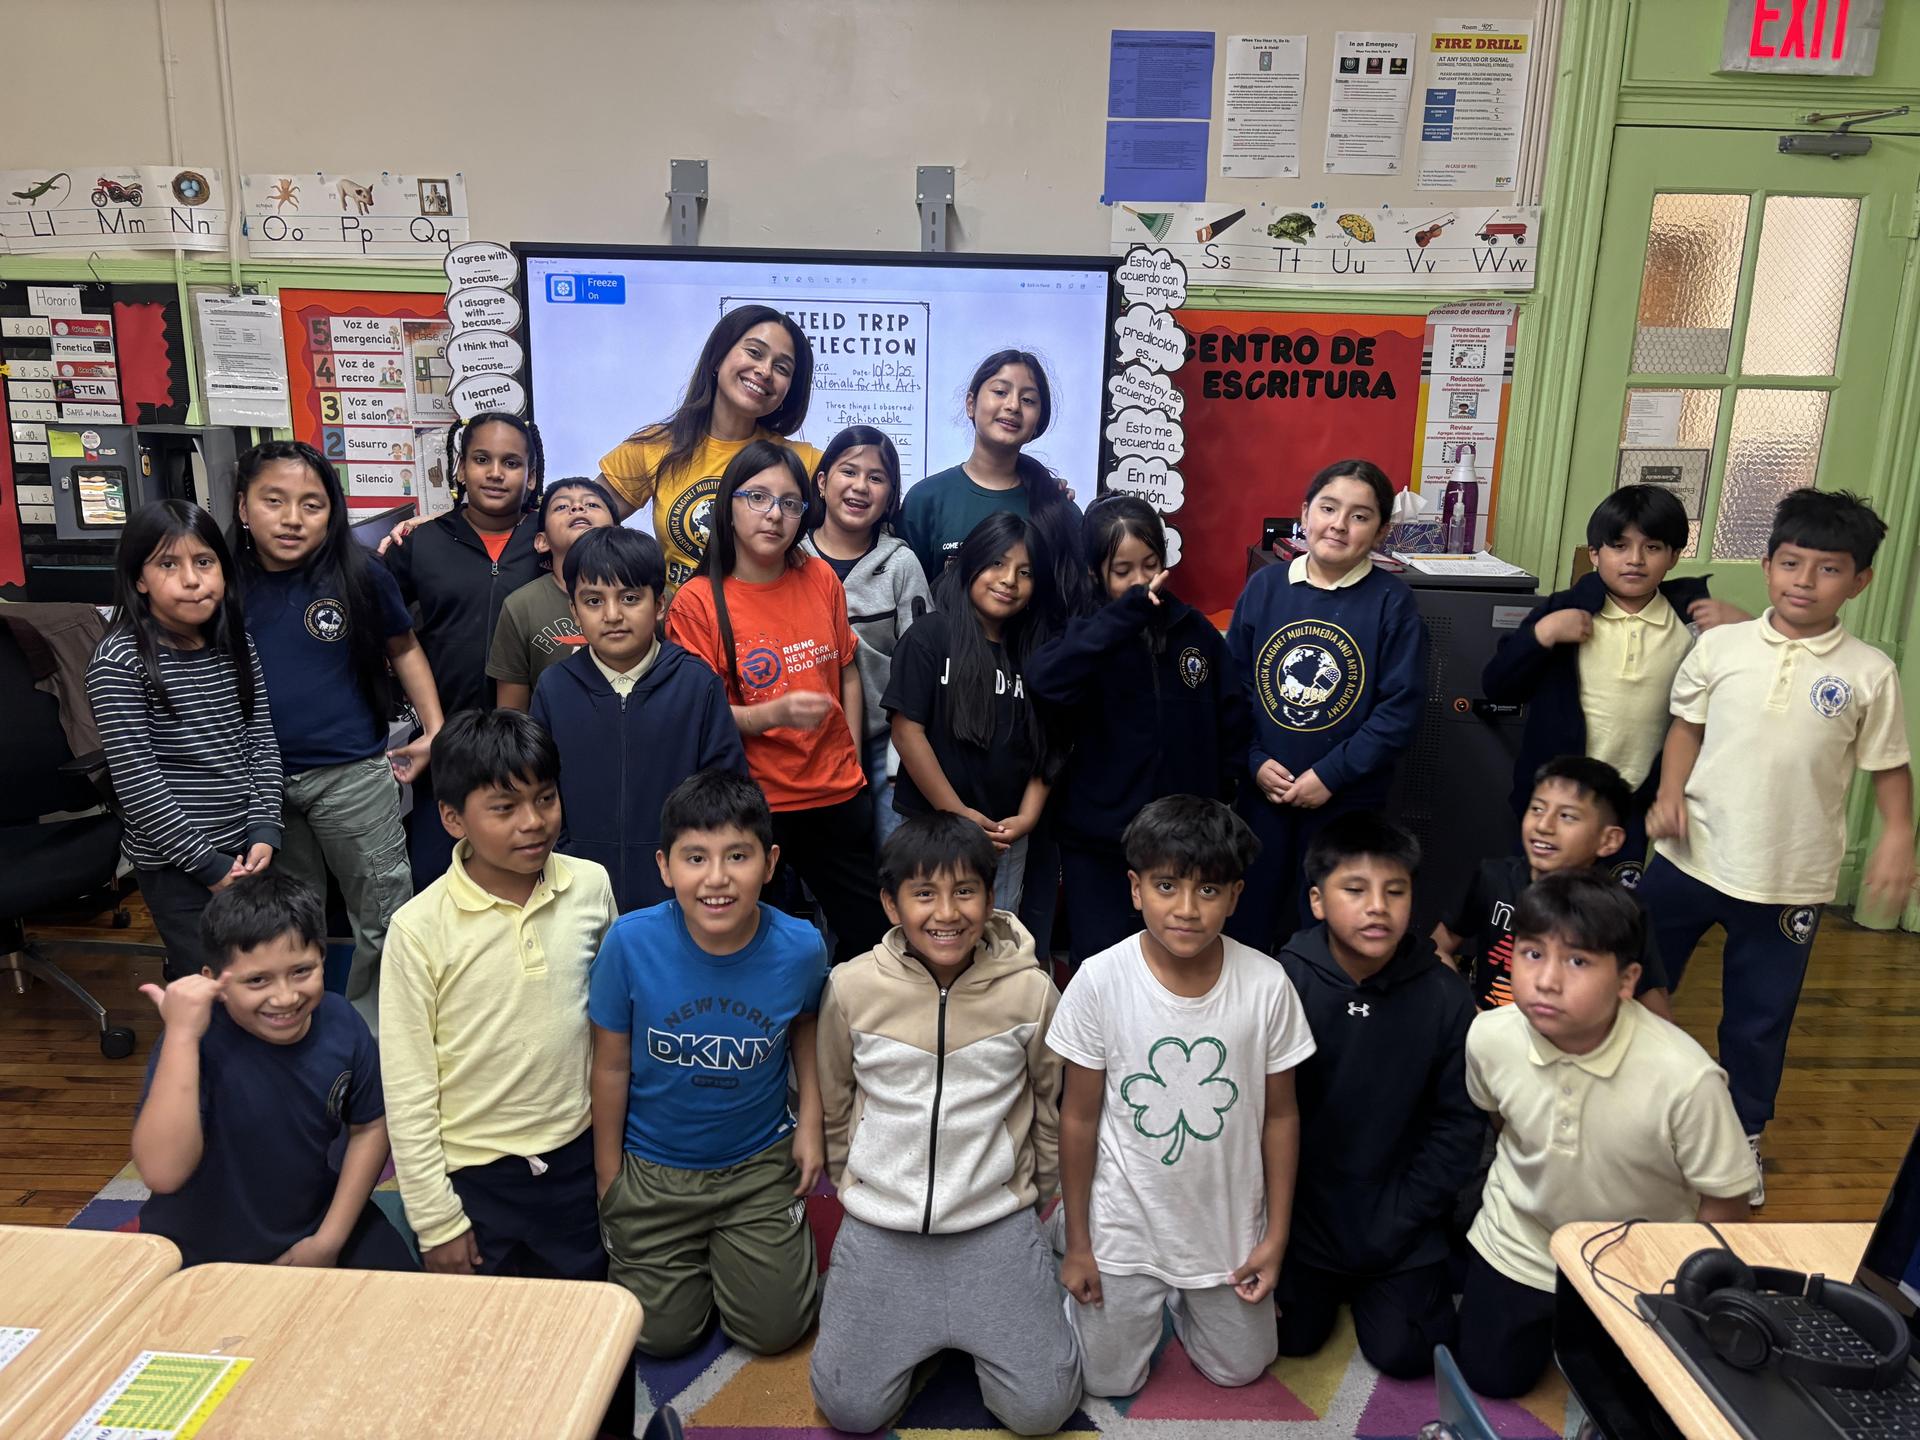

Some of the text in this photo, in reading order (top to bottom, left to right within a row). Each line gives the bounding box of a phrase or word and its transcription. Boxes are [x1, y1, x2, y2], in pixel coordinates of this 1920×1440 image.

[1434, 38, 1522, 50] FIRE DRILL
[28, 206, 210, 236] Ll Mm Nn
[262, 215, 451, 254] Oo Pp Qq
[452, 251, 508, 265] I agree with
[1130, 256, 1171, 271] Estoy de
[1202, 243, 1528, 274] Ss Tt Uu Vv Ww
[587, 278, 618, 288] Freeze
[1121, 271, 1178, 286] acuerdo con
[36, 289, 77, 306] Horario
[459, 296, 506, 308] I disagree
[587, 292, 599, 300] On
[465, 309, 486, 318] with
[343, 319, 380, 329] Voz de
[858, 313, 909, 332] TRIP
[1149, 315, 1162, 331] Mi
[311, 319, 330, 345] 5
[333, 333, 391, 345] emergencia
[1122, 326, 1179, 354] predicción
[56, 342, 93, 352] Fonetica
[457, 339, 509, 352] I think that
[806, 336, 916, 356] FLECTION
[1330, 336, 1377, 367] DE
[316, 357, 335, 384] 4
[338, 358, 375, 369] Voz de
[814, 363, 830, 372] era
[872, 359, 913, 382] 10/3/25
[341, 374, 375, 383] recreo
[852, 369, 871, 377] Date:
[73, 385, 107, 395] STEM
[461, 383, 511, 401] I learned
[855, 377, 872, 391] for
[871, 376, 891, 391] the
[895, 378, 921, 392] Arts
[1122, 371, 1182, 403] No estoy de
[1203, 370, 1396, 400] ESCRITURA
[322, 395, 340, 421] 3
[348, 397, 383, 407] Voz en
[826, 401, 846, 409] Three
[849, 403, 871, 413] things
[1115, 384, 1177, 416] acuerdo con
[347, 411, 387, 420] el salon
[838, 410, 902, 427] fashionable
[1126, 421, 1172, 437] Esto me
[326, 431, 344, 457] 2
[348, 440, 388, 449] Susurro
[1114, 436, 1165, 451] recuerda
[355, 474, 393, 483] Silencio
[1127, 468, 1167, 486] En mi
[670, 481, 720, 553] BUSHWICK MAGNET MULTI
[942, 542, 959, 550] COME
[531, 617, 583, 655] FIR
[782, 639, 815, 656] RISING
[785, 644, 830, 664] NEW YORK
[787, 660, 814, 674] ROAD
[1260, 625, 1358, 719] BUSHWICK MAGNET MULTIMEDIA AND ARTS ACADEMY
[664, 996, 776, 1034] NEW YORK
[647, 1026, 786, 1071] DKNY
